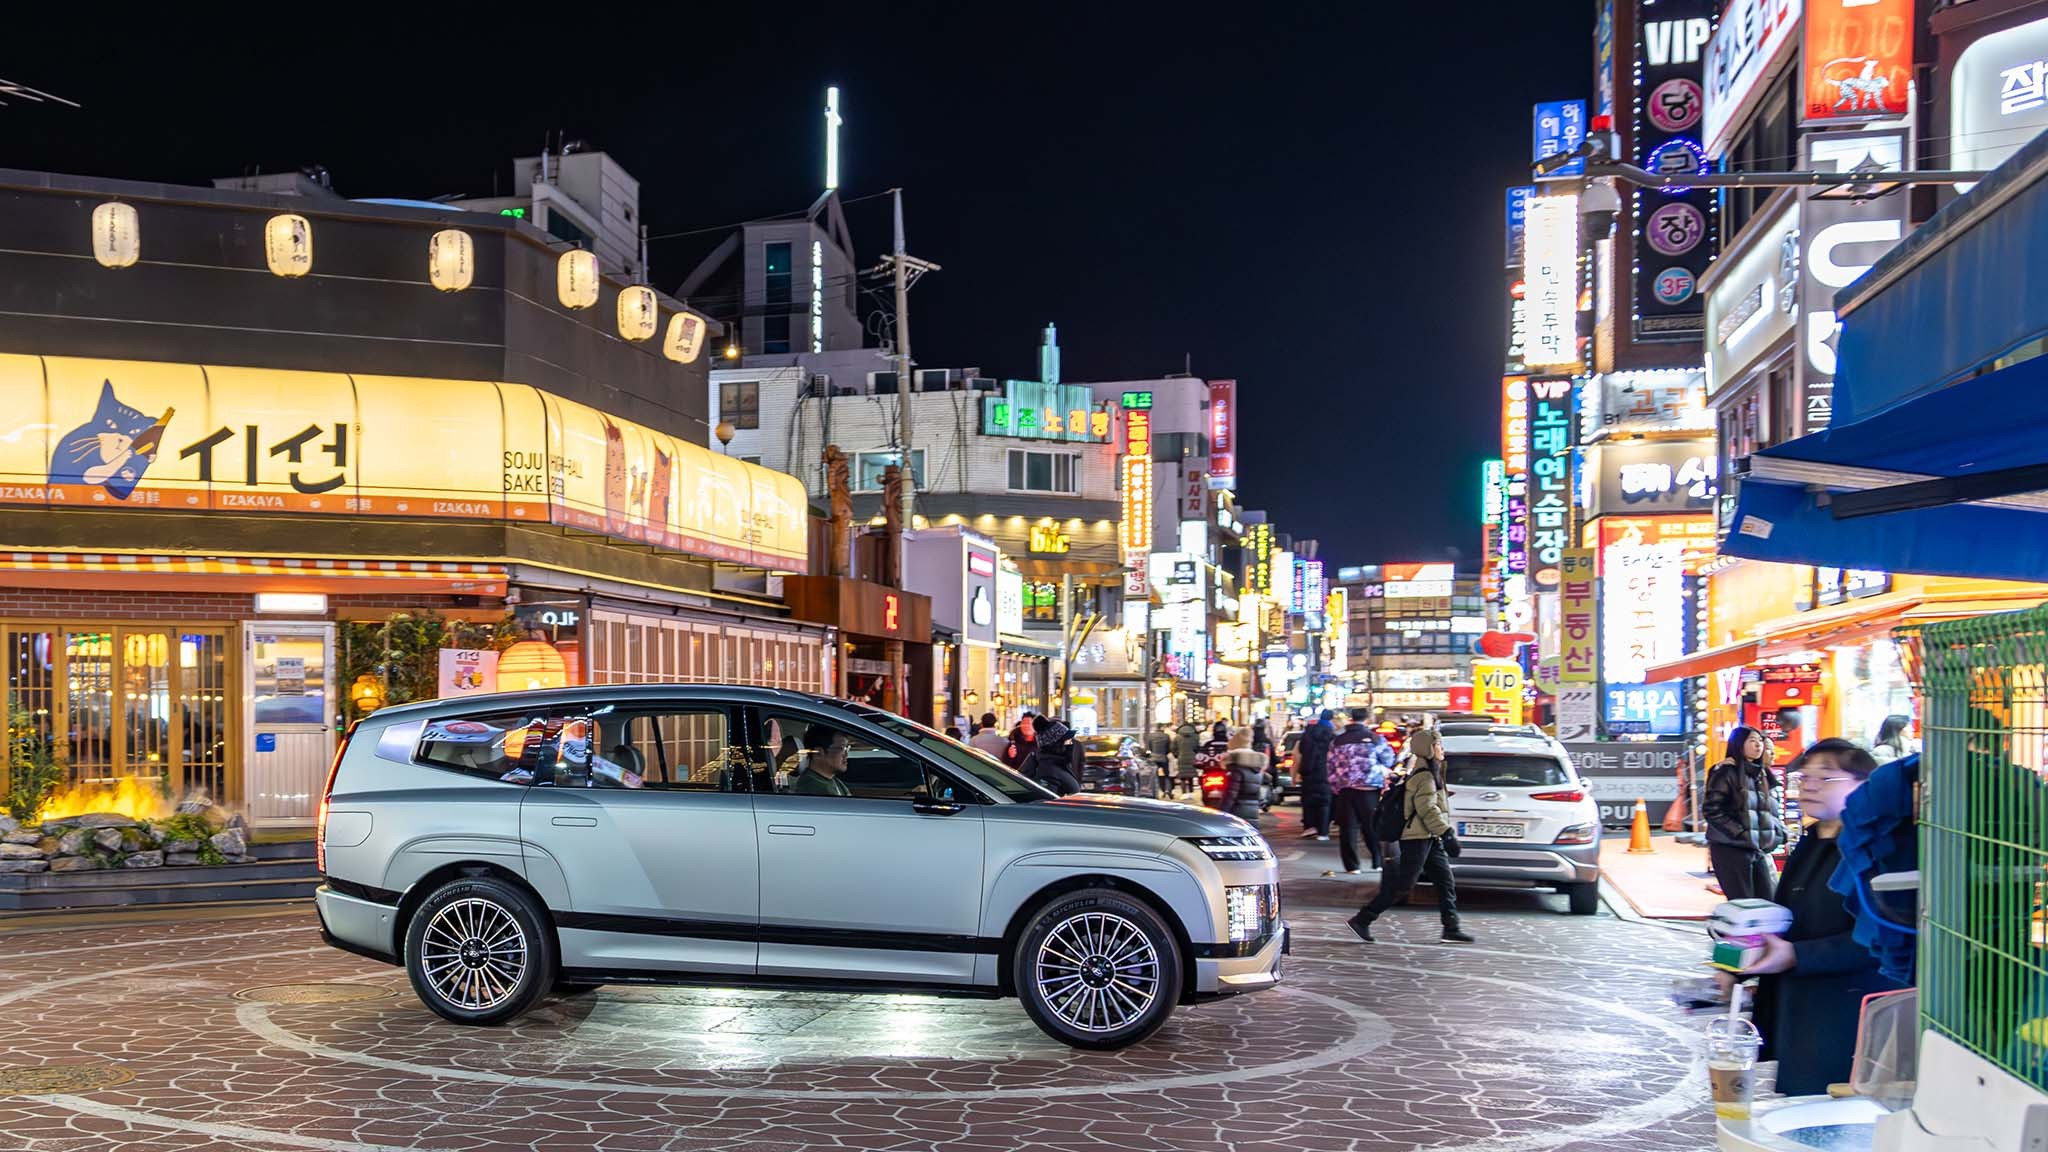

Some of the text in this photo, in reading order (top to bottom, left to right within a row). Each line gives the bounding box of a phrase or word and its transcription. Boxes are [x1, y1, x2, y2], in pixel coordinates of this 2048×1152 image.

[1644, 18, 1710, 65] VIP
[1812, 103, 1828, 113] B1
[1661, 278, 1688, 296] 3F
[1532, 381, 1571, 399] VIP
[1044, 407, 1110, 436] 노래방
[1604, 413, 1621, 424] B1
[503, 450, 543, 470] SOJU
[503, 473, 543, 492] SAKE
[1532, 402, 1568, 563] 노래연습장
[0, 487, 65, 501] IZAKAYA
[223, 494, 285, 508] IZAKAYA
[433, 501, 490, 515] IZAKAYA
[1563, 556, 1594, 573] 동아
[1564, 581, 1594, 674] 부동산
[1482, 670, 1516, 689] vip
